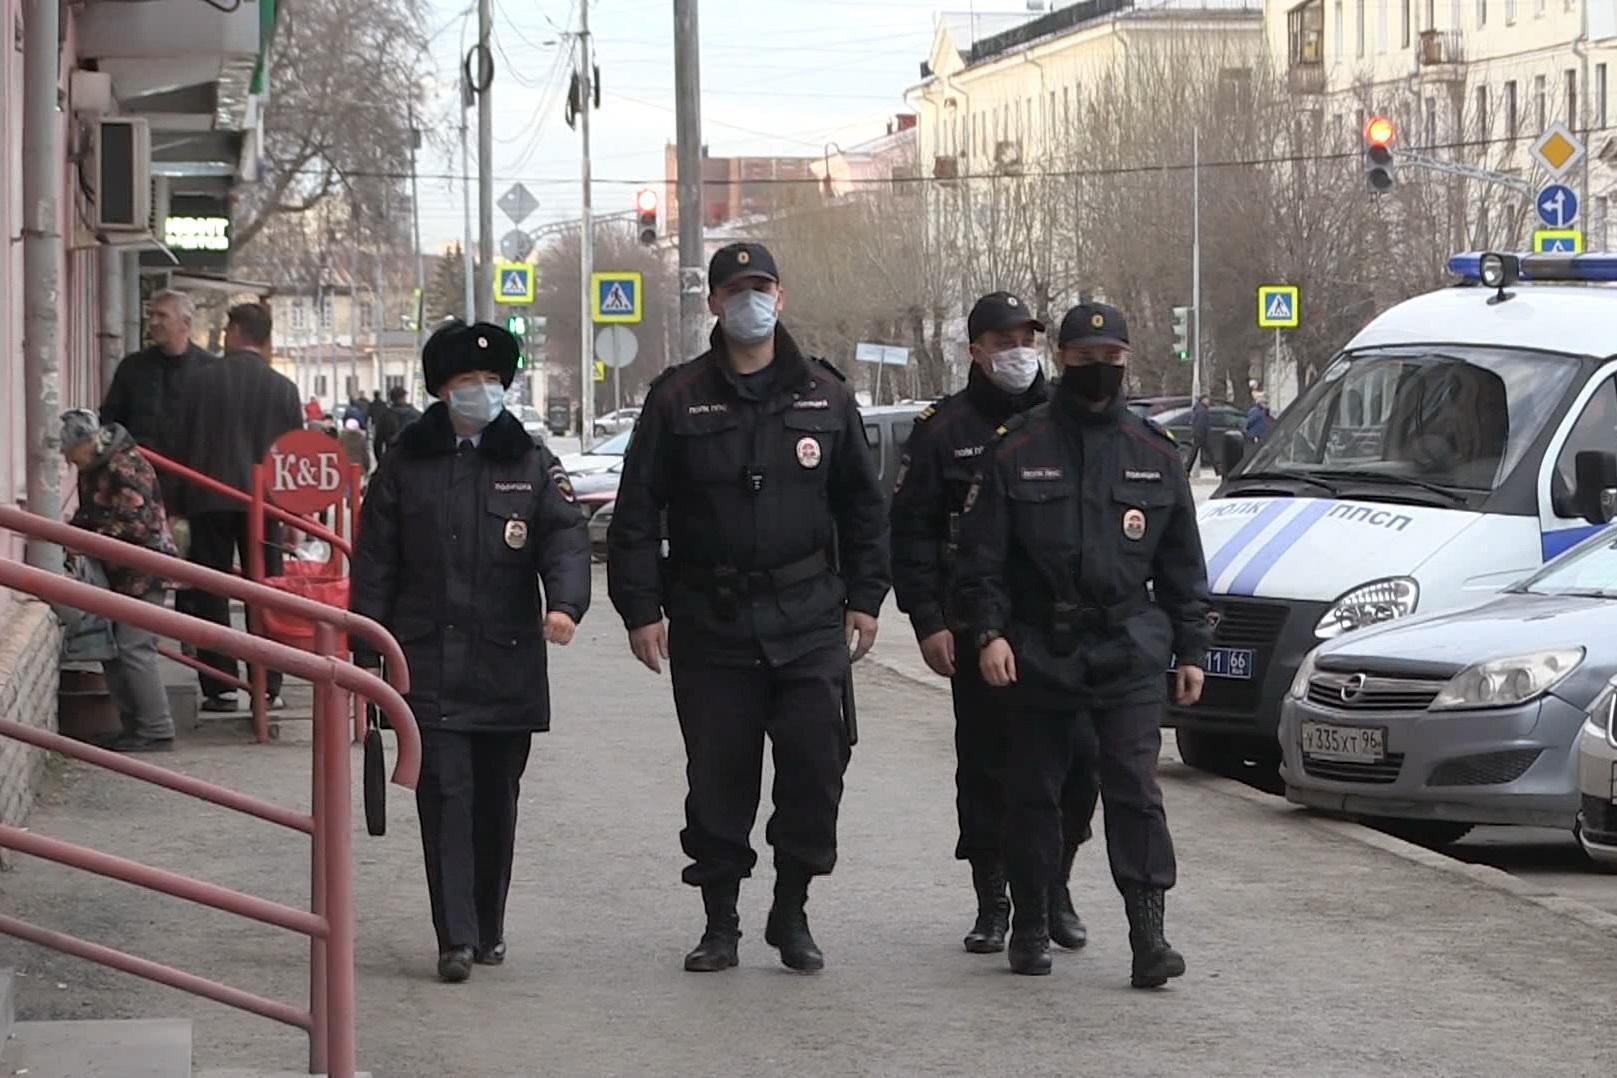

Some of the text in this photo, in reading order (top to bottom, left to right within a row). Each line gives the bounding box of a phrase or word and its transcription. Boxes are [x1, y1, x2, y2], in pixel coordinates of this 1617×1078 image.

[271, 451, 340, 491] К&Б
[1328, 503, 1413, 531] ППСП
[1230, 652, 1246, 669] 66
